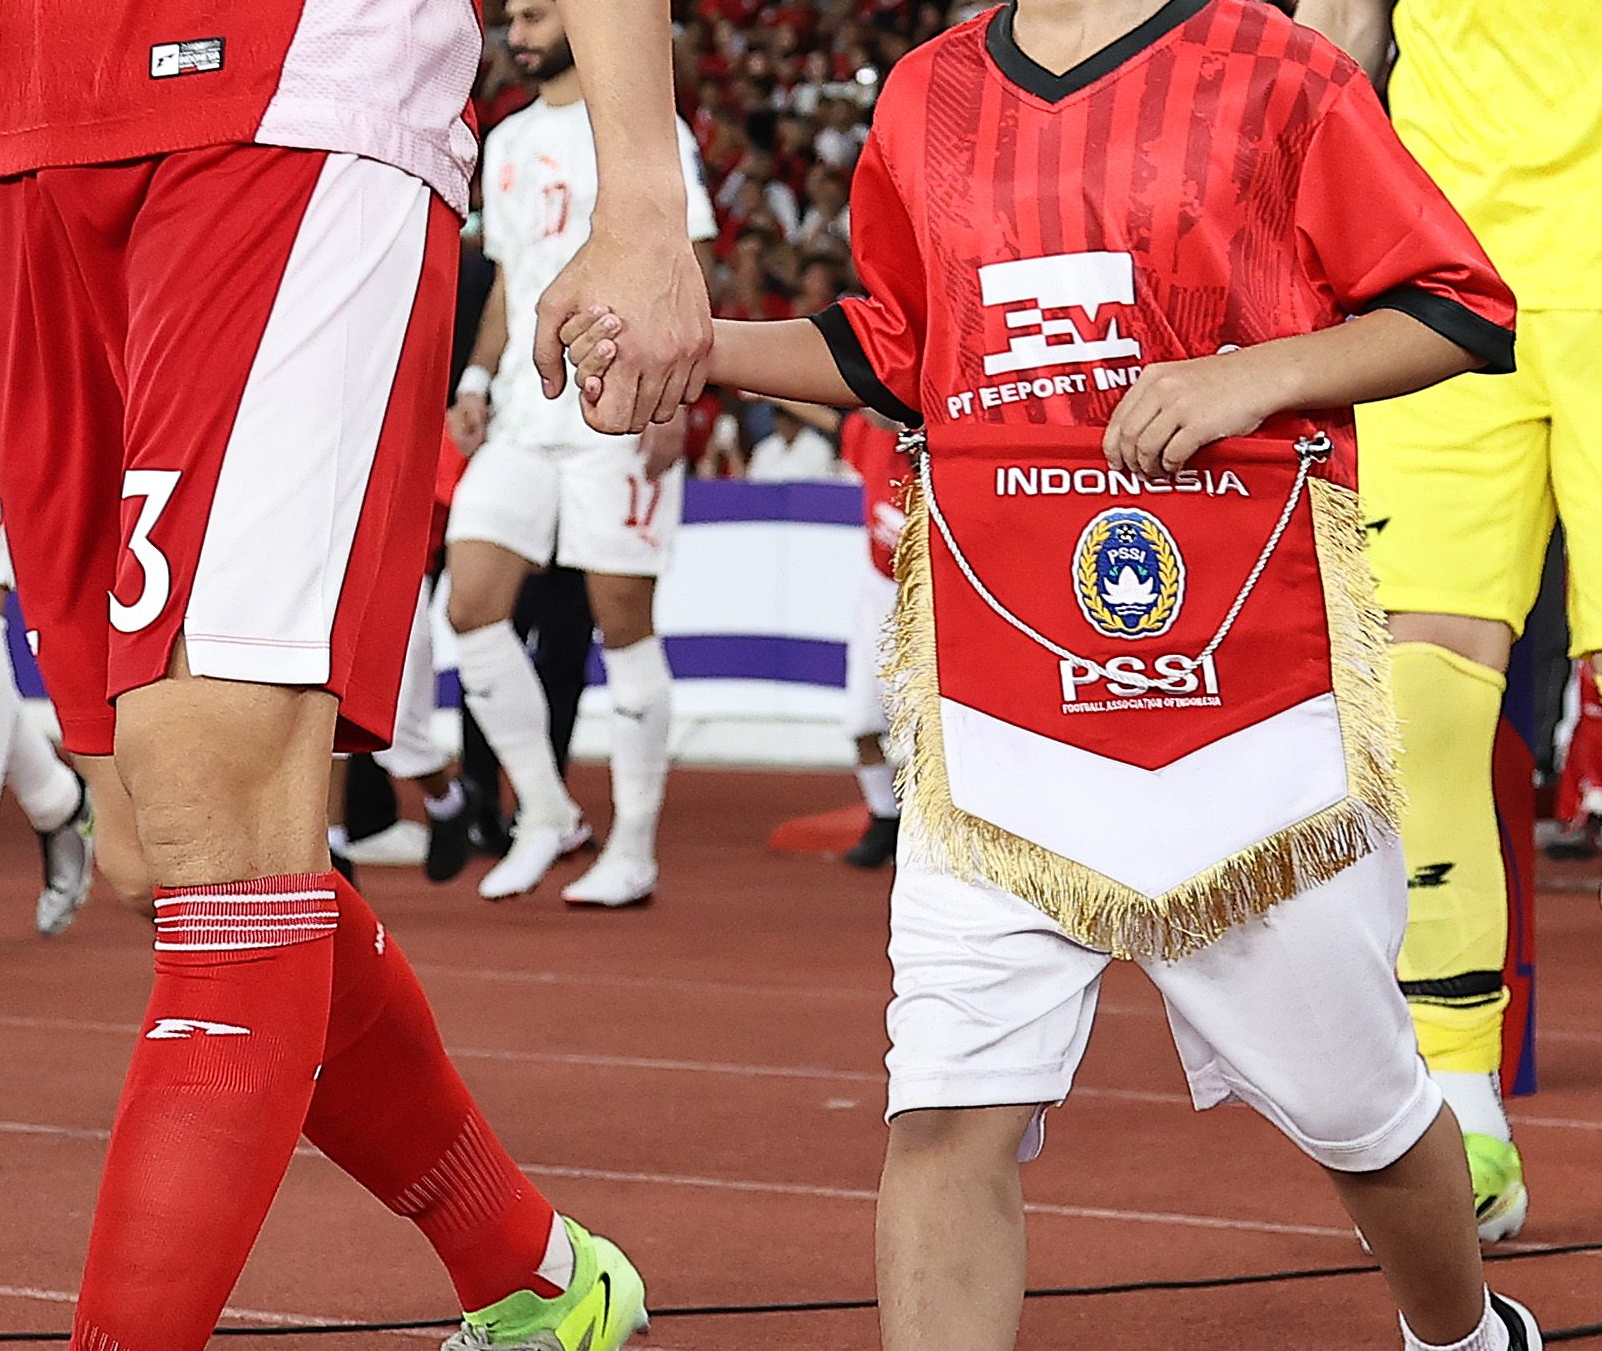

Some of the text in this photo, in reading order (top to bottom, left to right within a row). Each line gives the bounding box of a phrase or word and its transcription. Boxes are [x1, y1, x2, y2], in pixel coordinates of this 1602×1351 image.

[947, 391, 975, 419] PT
[979, 374, 1087, 409] EEPORT
[996, 466, 1251, 497] INDONESIA
[107, 469, 182, 634] 3
[1107, 547, 1147, 566] PSSI
[1059, 653, 1219, 702] PSSI
[1062, 701, 1106, 715] FOOTBALL
[1106, 698, 1164, 711] ASSOCIATION
